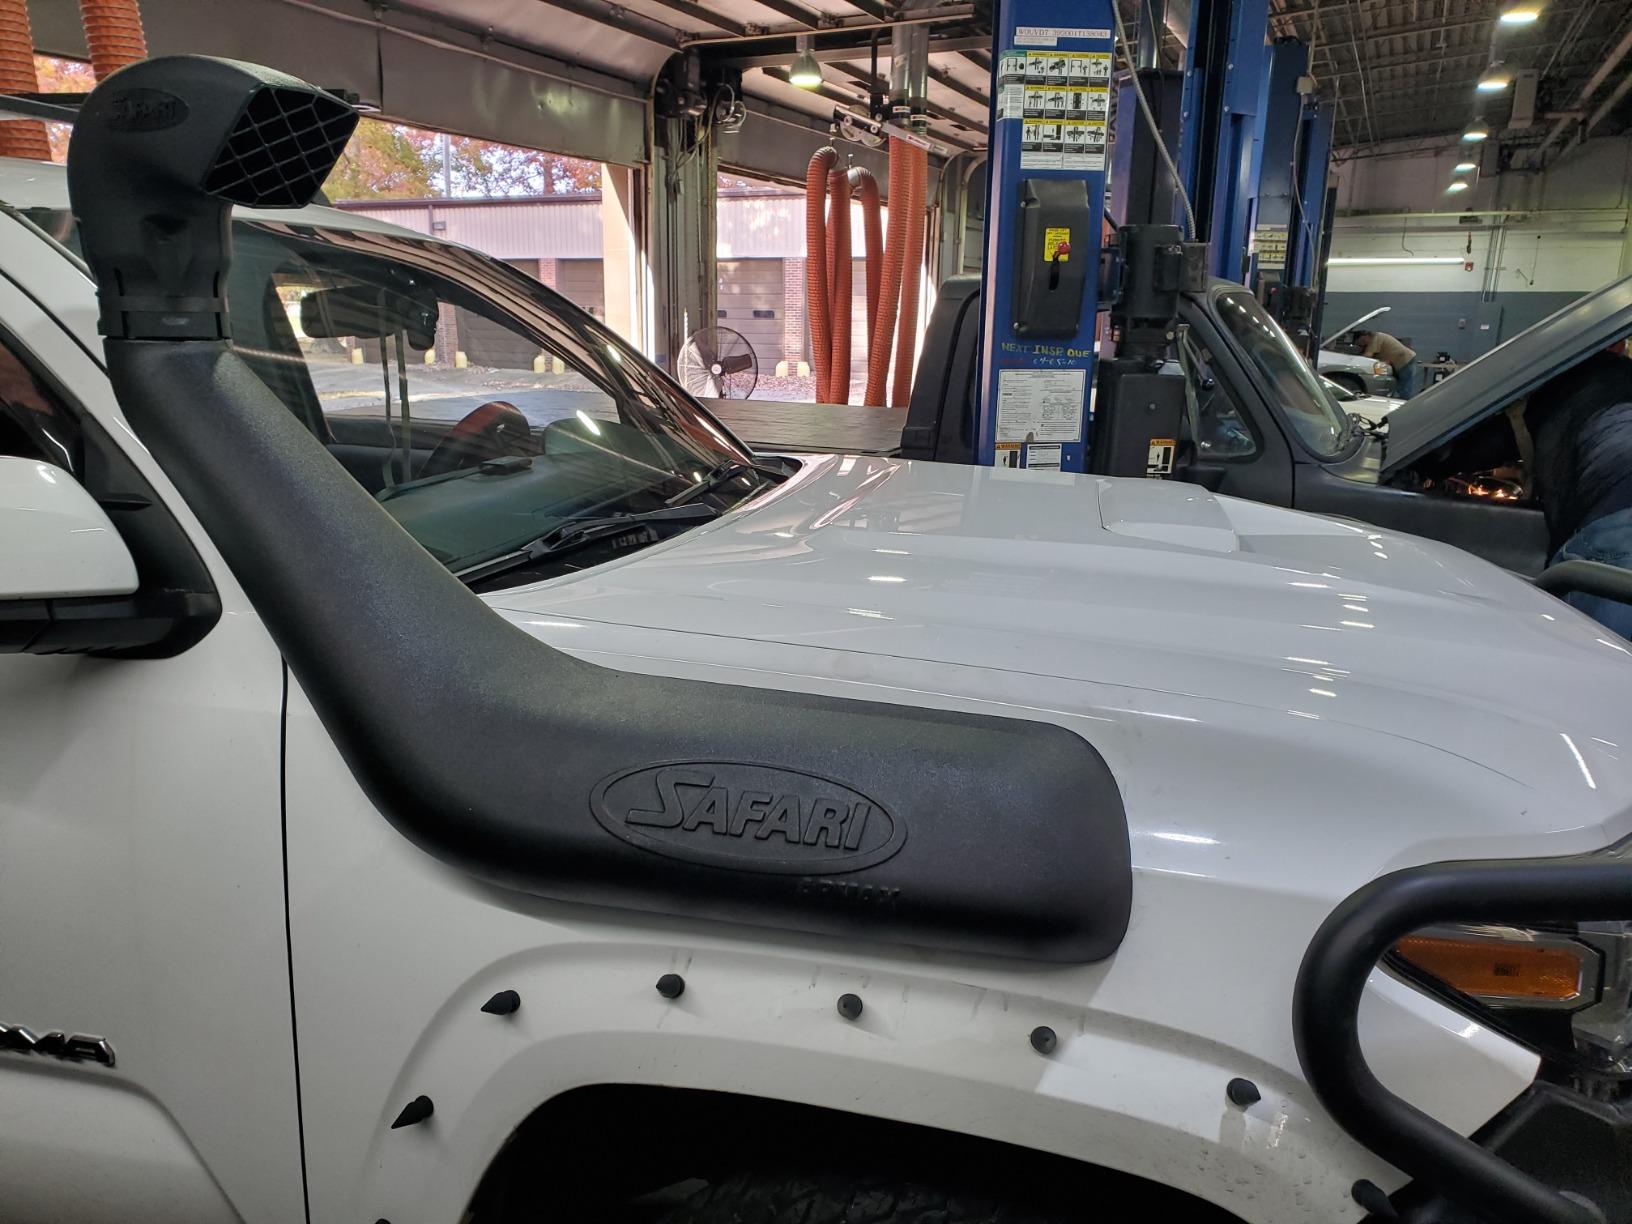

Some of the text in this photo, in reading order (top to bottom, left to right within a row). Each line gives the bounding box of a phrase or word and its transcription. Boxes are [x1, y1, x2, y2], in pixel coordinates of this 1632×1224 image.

[1001, 342, 1032, 354] NEXT
[1067, 348, 1091, 357] DUE
[626, 769, 872, 850] SAFARI
